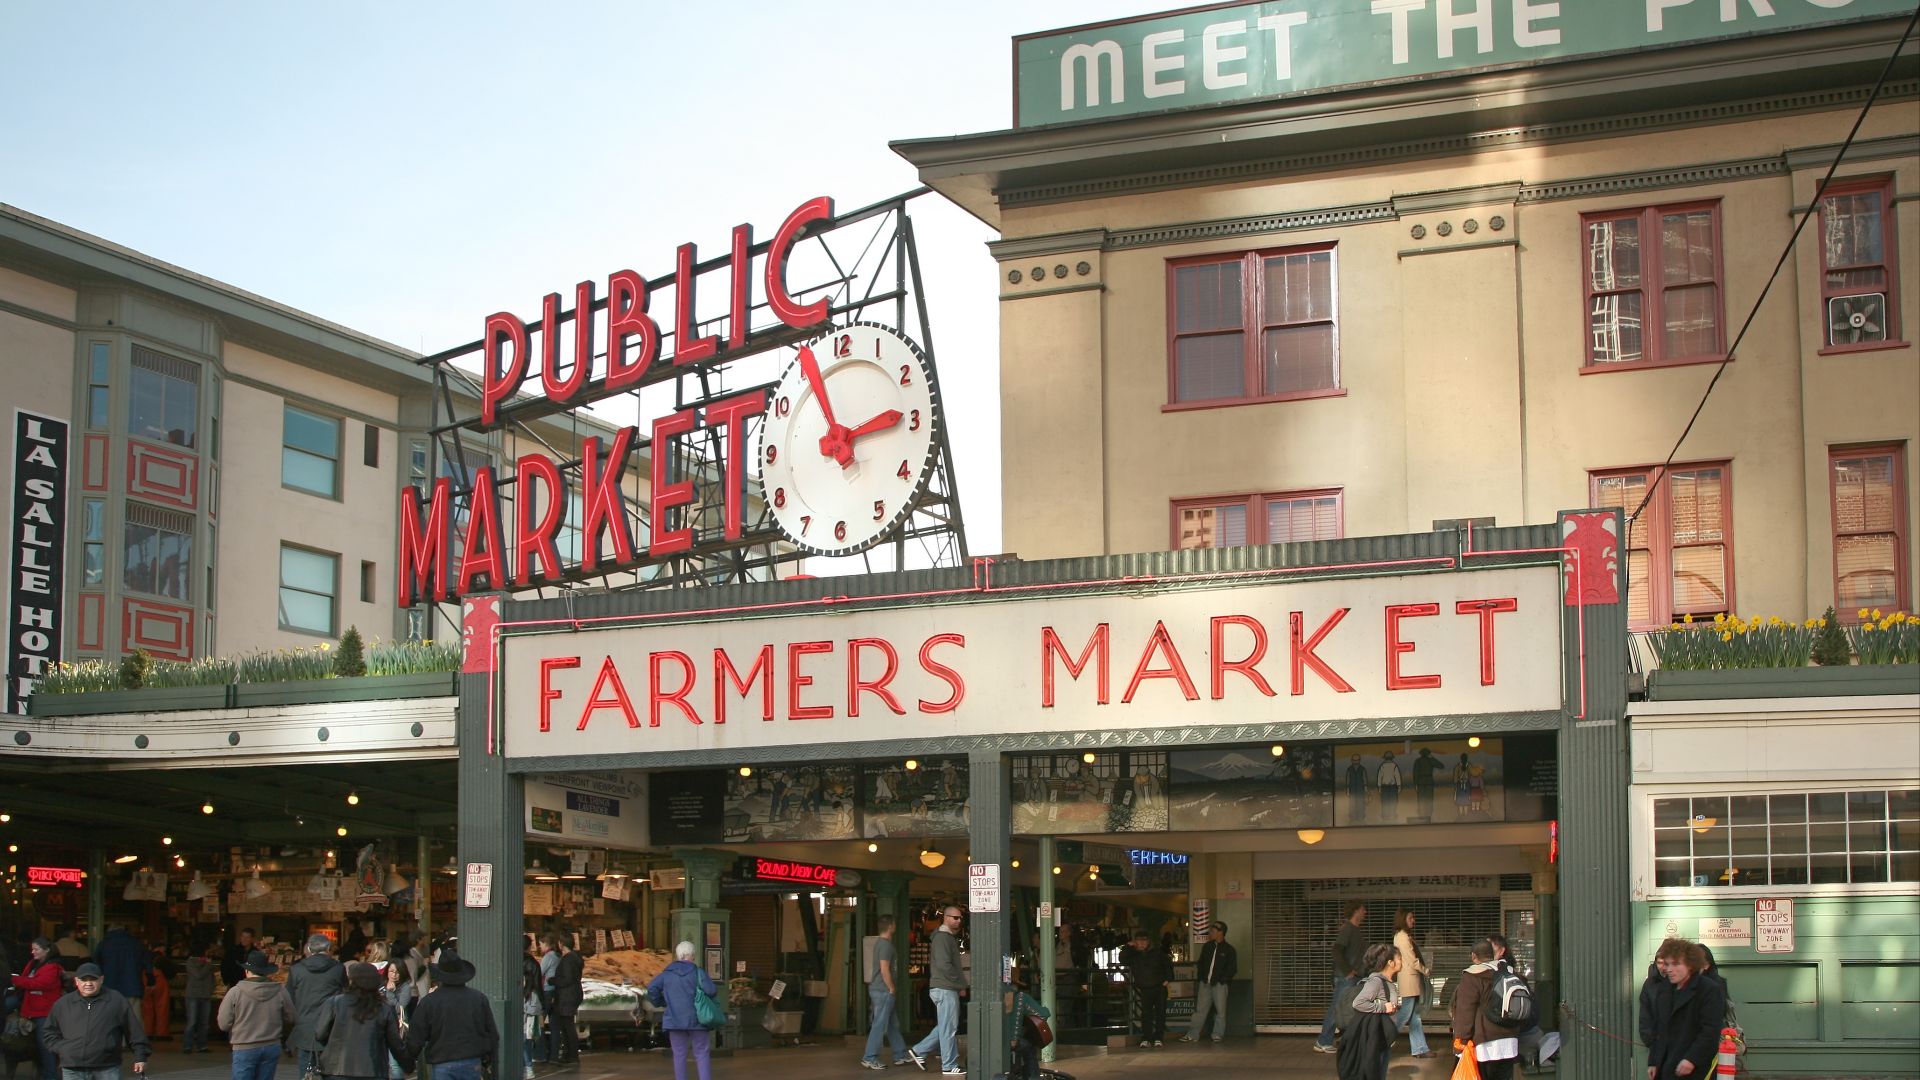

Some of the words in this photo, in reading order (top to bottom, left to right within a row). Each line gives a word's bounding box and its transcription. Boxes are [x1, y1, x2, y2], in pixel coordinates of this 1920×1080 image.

[1060, 11, 1308, 111] MEET
[1371, 0, 1562, 65] THE
[482, 196, 835, 427] PUBLIC
[834, 334, 852, 358] 12
[875, 338, 881, 358] 1
[900, 365, 911, 385] 2
[775, 396, 790, 417] 10
[909, 409, 920, 431] 3
[25, 418, 57, 469] LA
[766, 444, 777, 464] 9
[896, 460, 911, 480] 4
[398, 387, 772, 609] MARKET
[774, 487, 786, 508] 8
[873, 500, 885, 520] 5
[21, 478, 55, 595] SALLE
[800, 515, 811, 537] 7
[834, 520, 846, 541] 6
[540, 633, 967, 732] FARMERS
[1041, 598, 1518, 708] MARKET
[470, 864, 480, 874] NO
[757, 859, 789, 876] SOUND
[790, 862, 813, 878] VIEW
[814, 866, 836, 880] CAFE
[972, 866, 984, 876] NO
[470, 876, 488, 884] STOPS
[972, 878, 996, 887] STOPS
[1759, 900, 1773, 911] NO
[1760, 913, 1789, 923] STOPS
